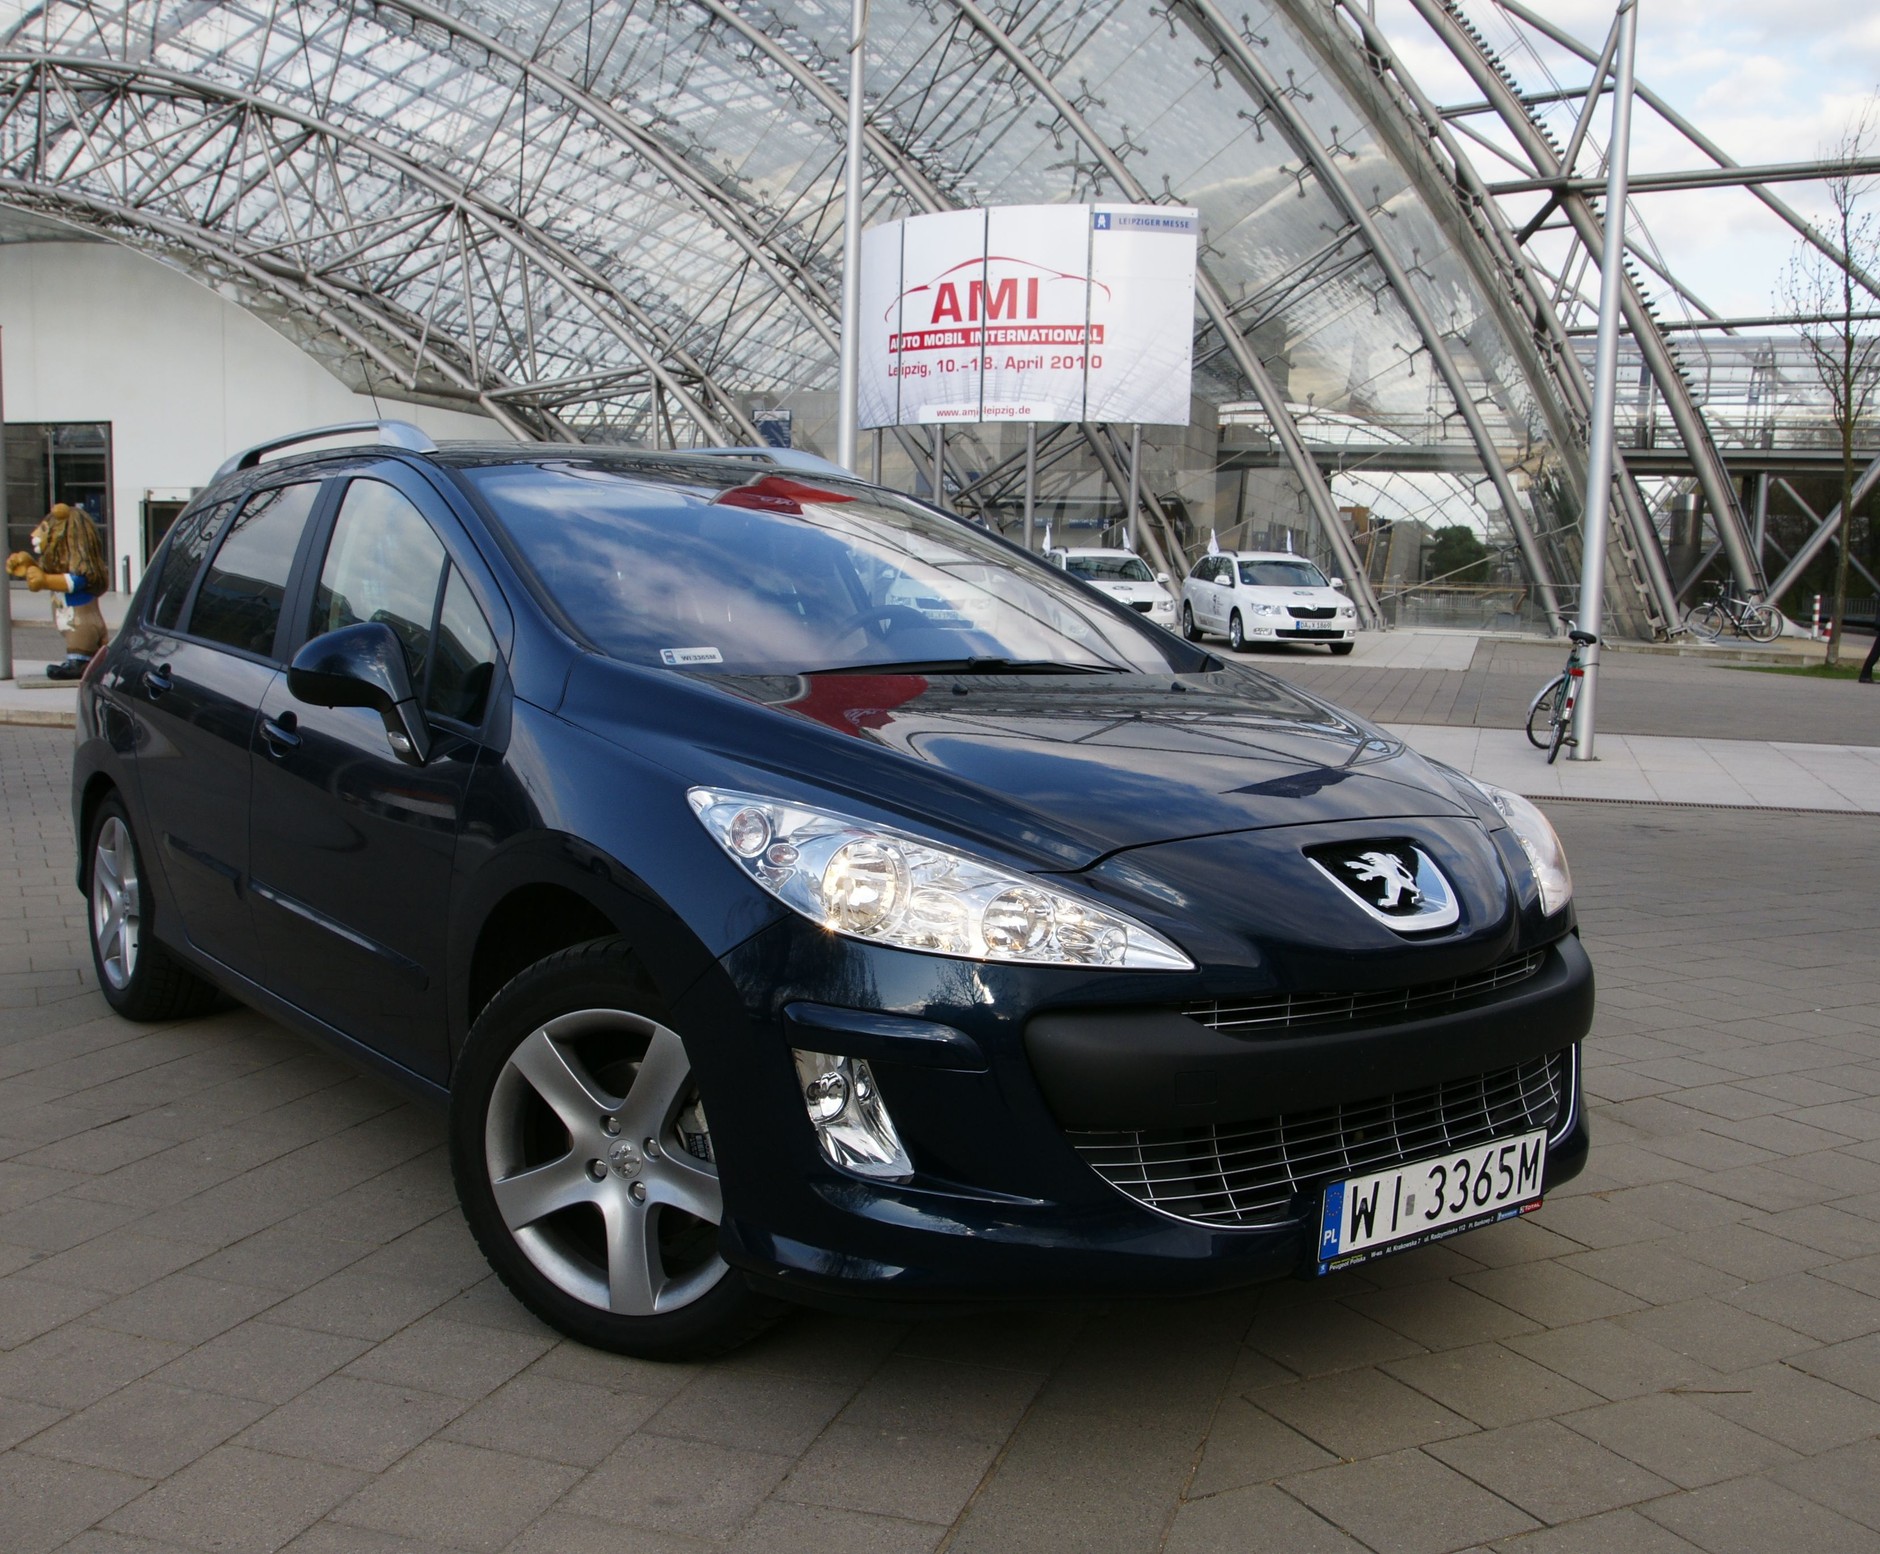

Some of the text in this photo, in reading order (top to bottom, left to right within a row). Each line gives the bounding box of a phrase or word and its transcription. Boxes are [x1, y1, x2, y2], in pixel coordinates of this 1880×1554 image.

[1119, 218, 1189, 229] LEIPZIGER MESSE
[930, 277, 1039, 324] AMI
[924, 332, 966, 347] MOBIL
[970, 328, 1102, 344] INTERNATIONAL
[888, 361, 931, 378] Leipzig,
[1005, 355, 1043, 373] April
[1050, 355, 1103, 370] 2010
[1350, 1137, 1541, 1243] WI 3365M
[1323, 1228, 1338, 1246] PL
